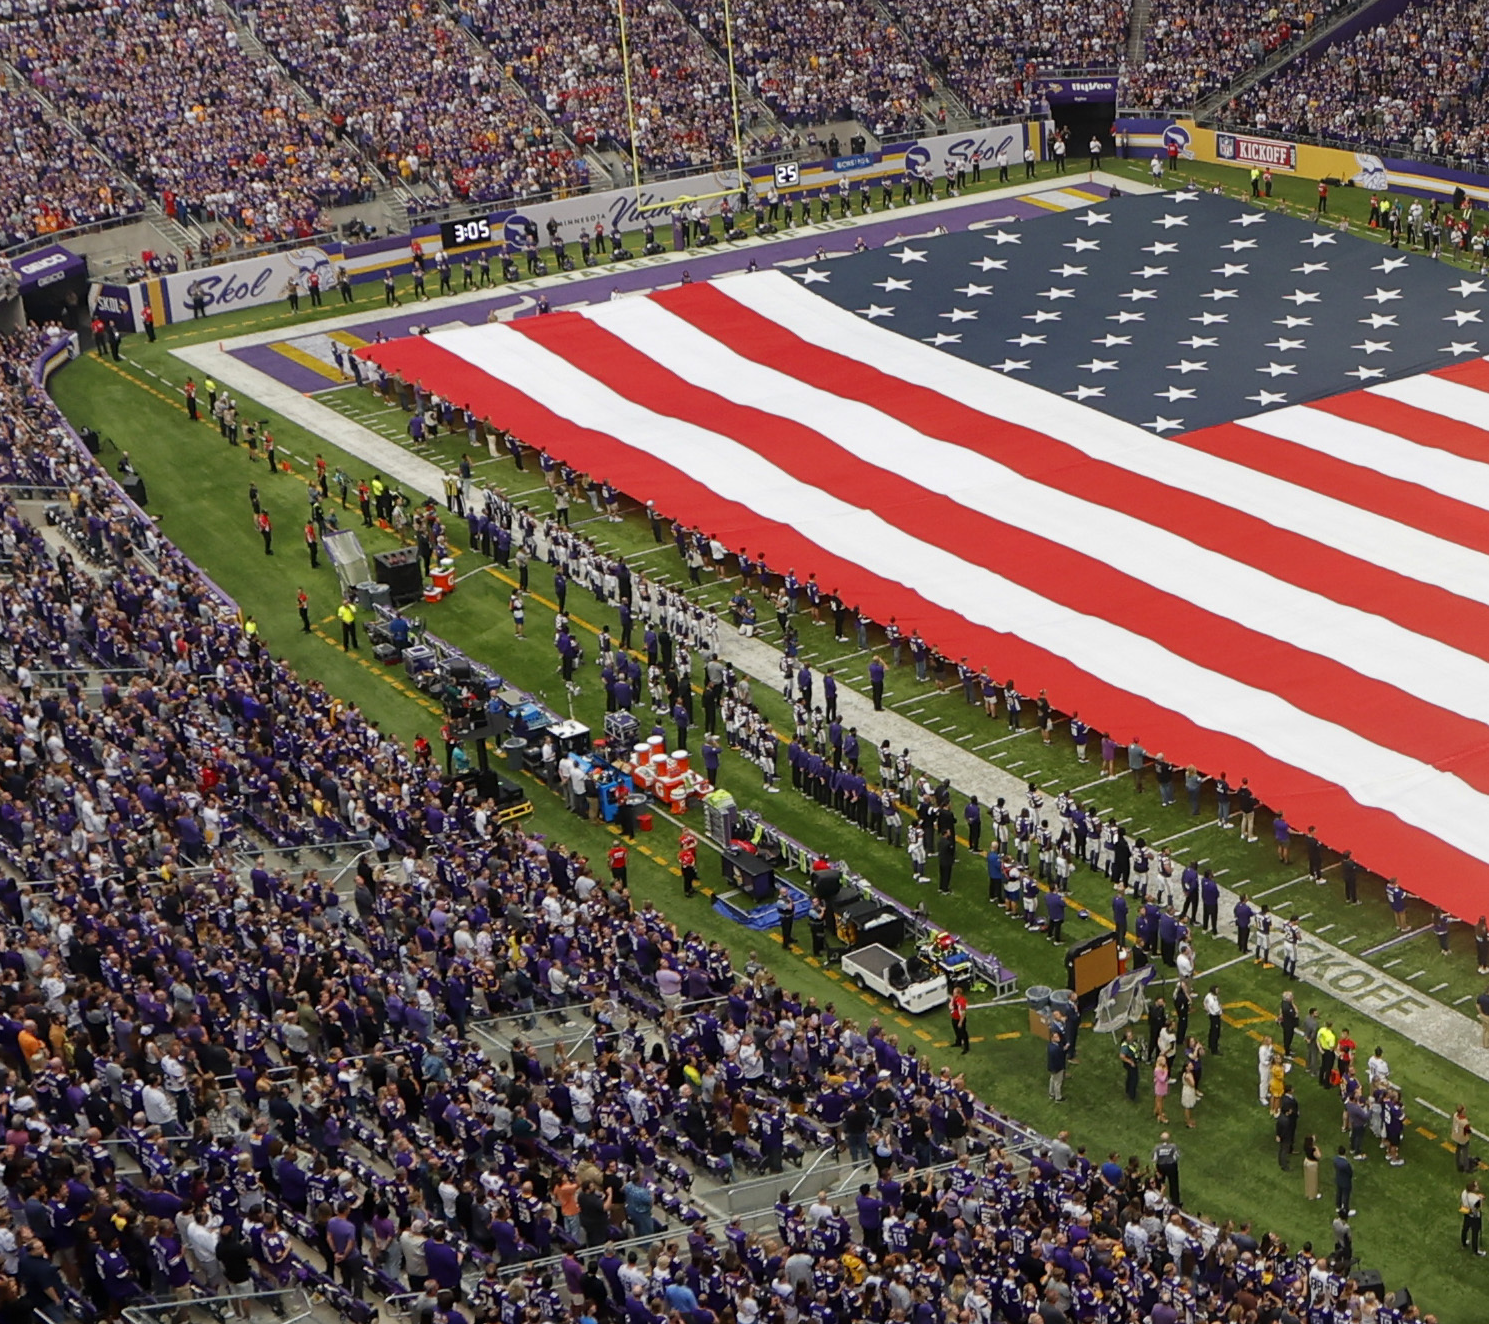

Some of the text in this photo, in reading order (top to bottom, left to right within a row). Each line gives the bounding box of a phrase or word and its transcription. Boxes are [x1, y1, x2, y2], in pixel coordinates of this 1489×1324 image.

[1237, 140, 1286, 165] KICKOFF
[777, 165, 797, 184] 25
[453, 219, 490, 241] 3:05
[557, 213, 606, 228] MINNESOTA
[20, 253, 68, 274] GEICO
[505, 219, 859, 292] IT TAKES ALL OF US
[37, 272, 66, 288] GEICO
[184, 267, 272, 311] Skol
[97, 295, 123, 314] SKOL
